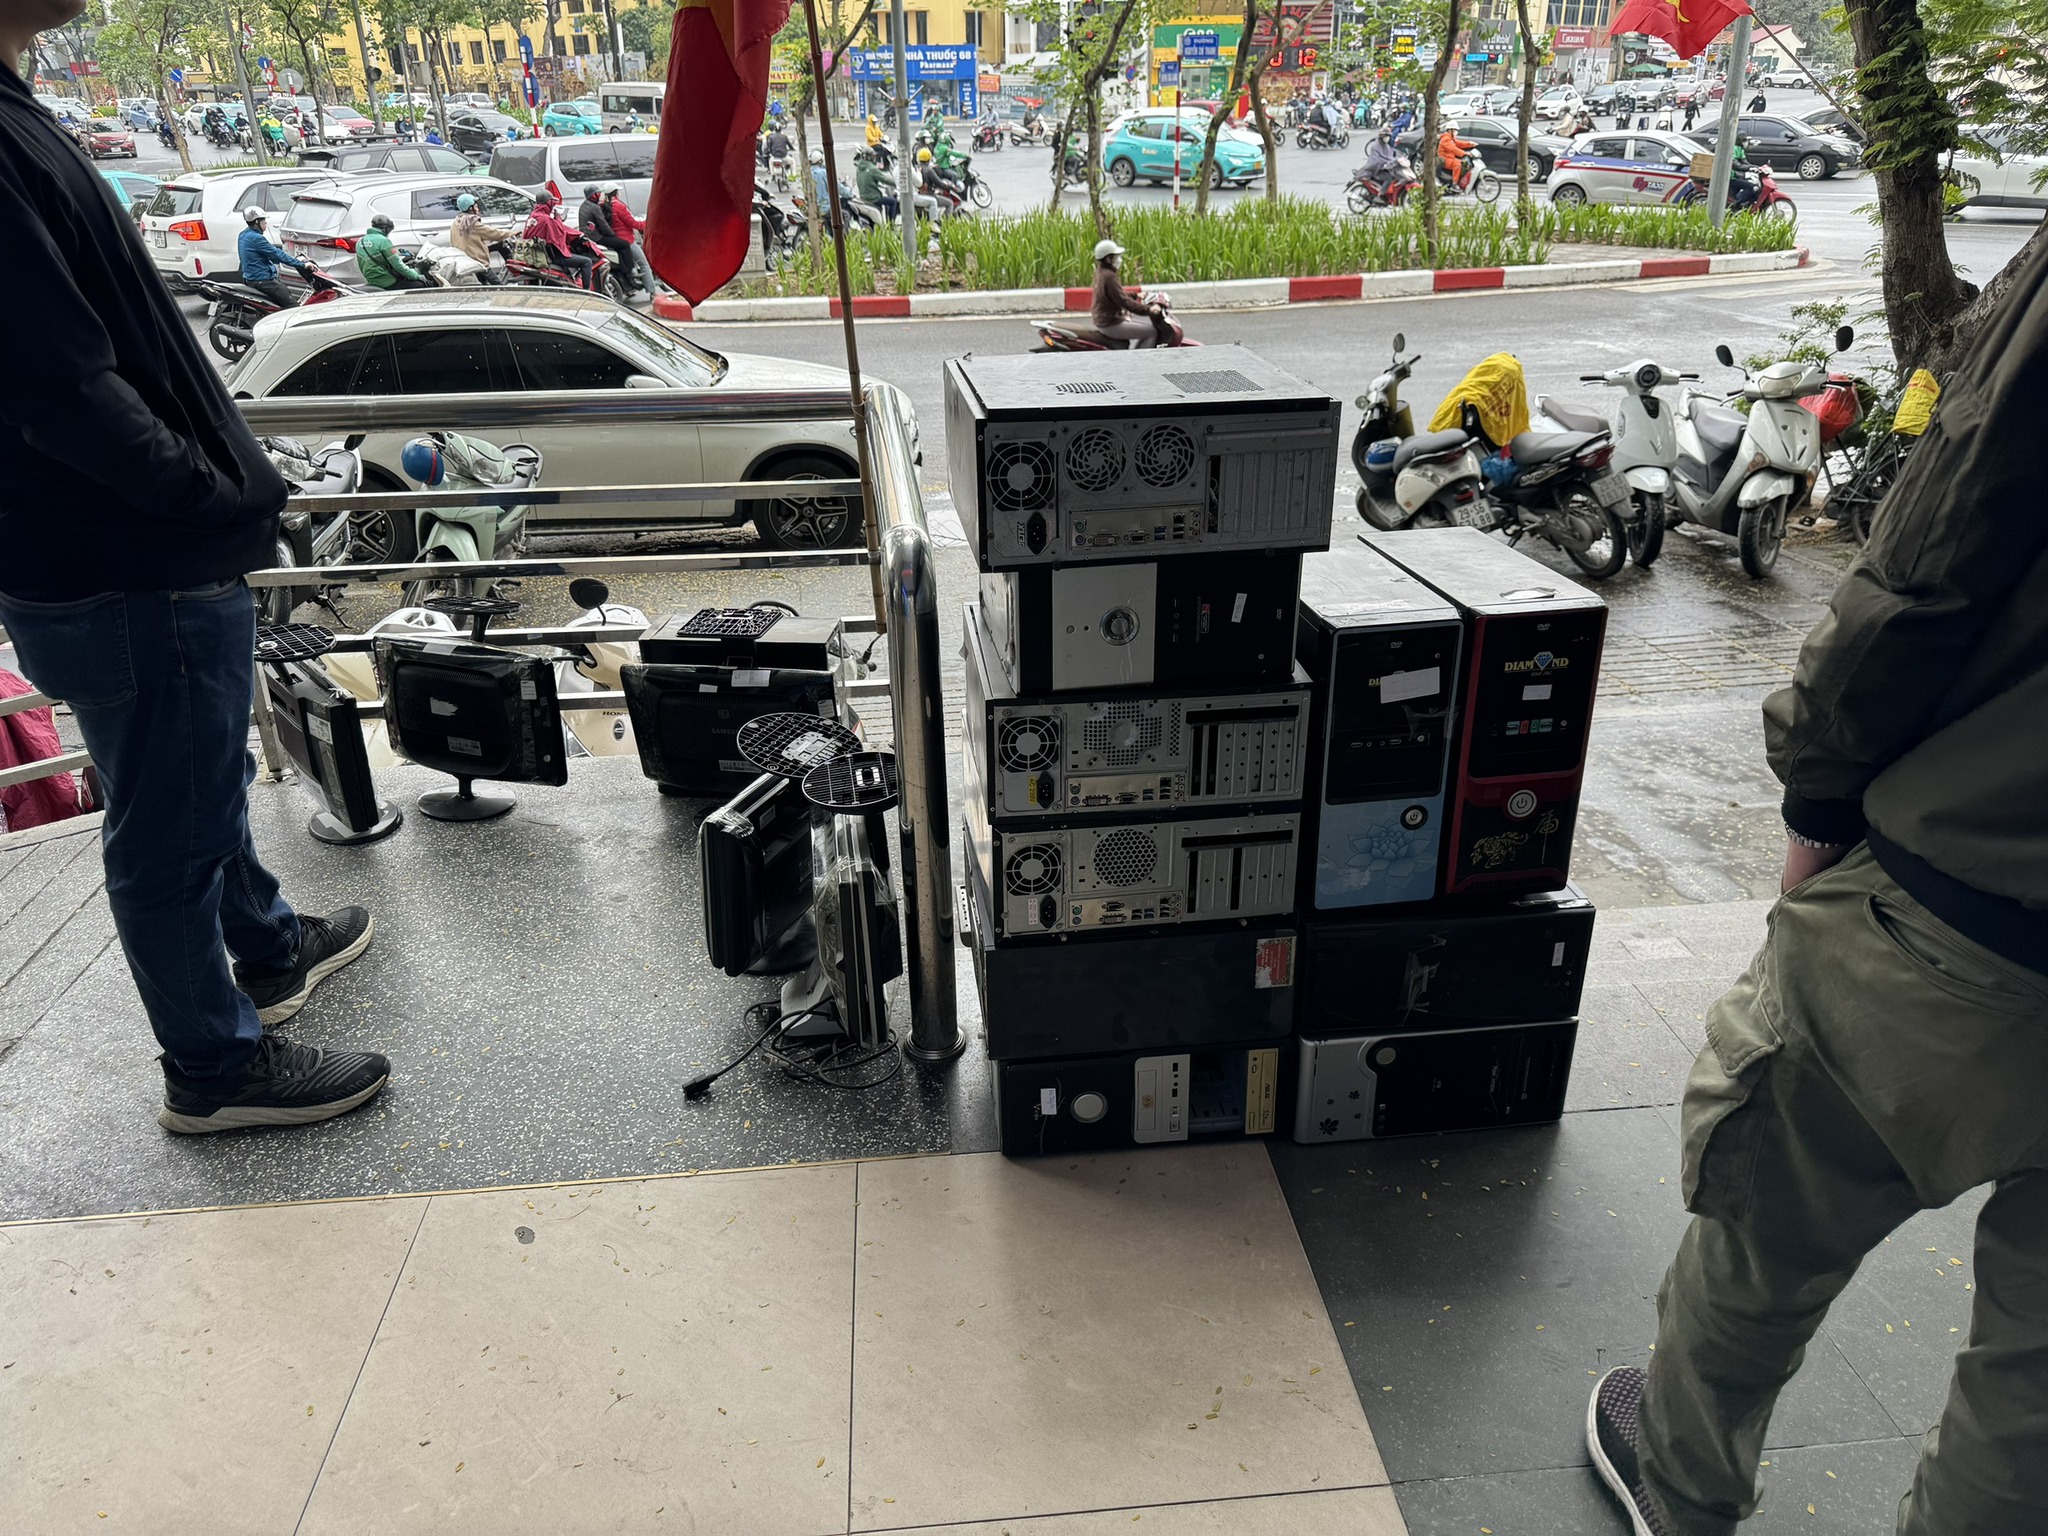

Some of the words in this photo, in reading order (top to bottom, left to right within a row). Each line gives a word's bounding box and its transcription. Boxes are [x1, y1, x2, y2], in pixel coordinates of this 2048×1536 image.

[925, 48, 958, 61] THUỐC
[958, 50, 972, 60] 68
[1648, 181, 1665, 190] TAXI
